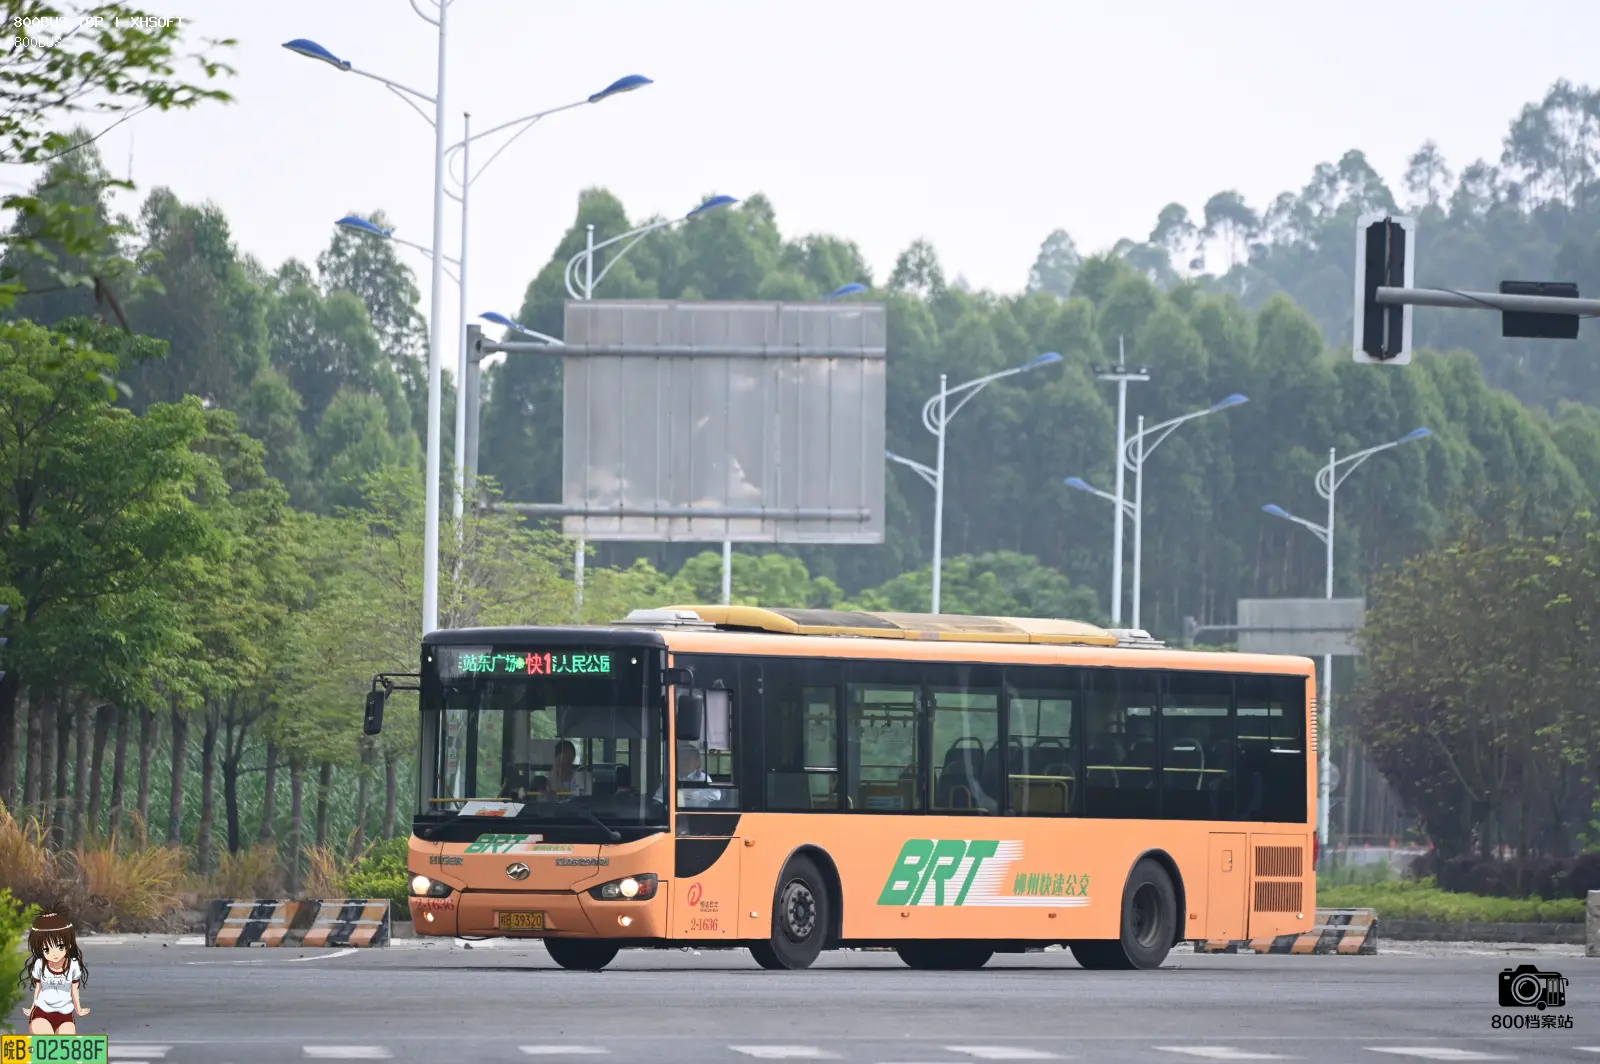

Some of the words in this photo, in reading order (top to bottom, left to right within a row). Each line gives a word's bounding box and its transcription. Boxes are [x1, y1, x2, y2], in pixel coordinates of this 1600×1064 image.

[525, 652, 552, 675] 快1
[463, 833, 529, 854] BRT
[876, 838, 1000, 907] BRT
[1013, 872, 1092, 897] 柳州快速公交
[514, 914, 542, 927] 39320
